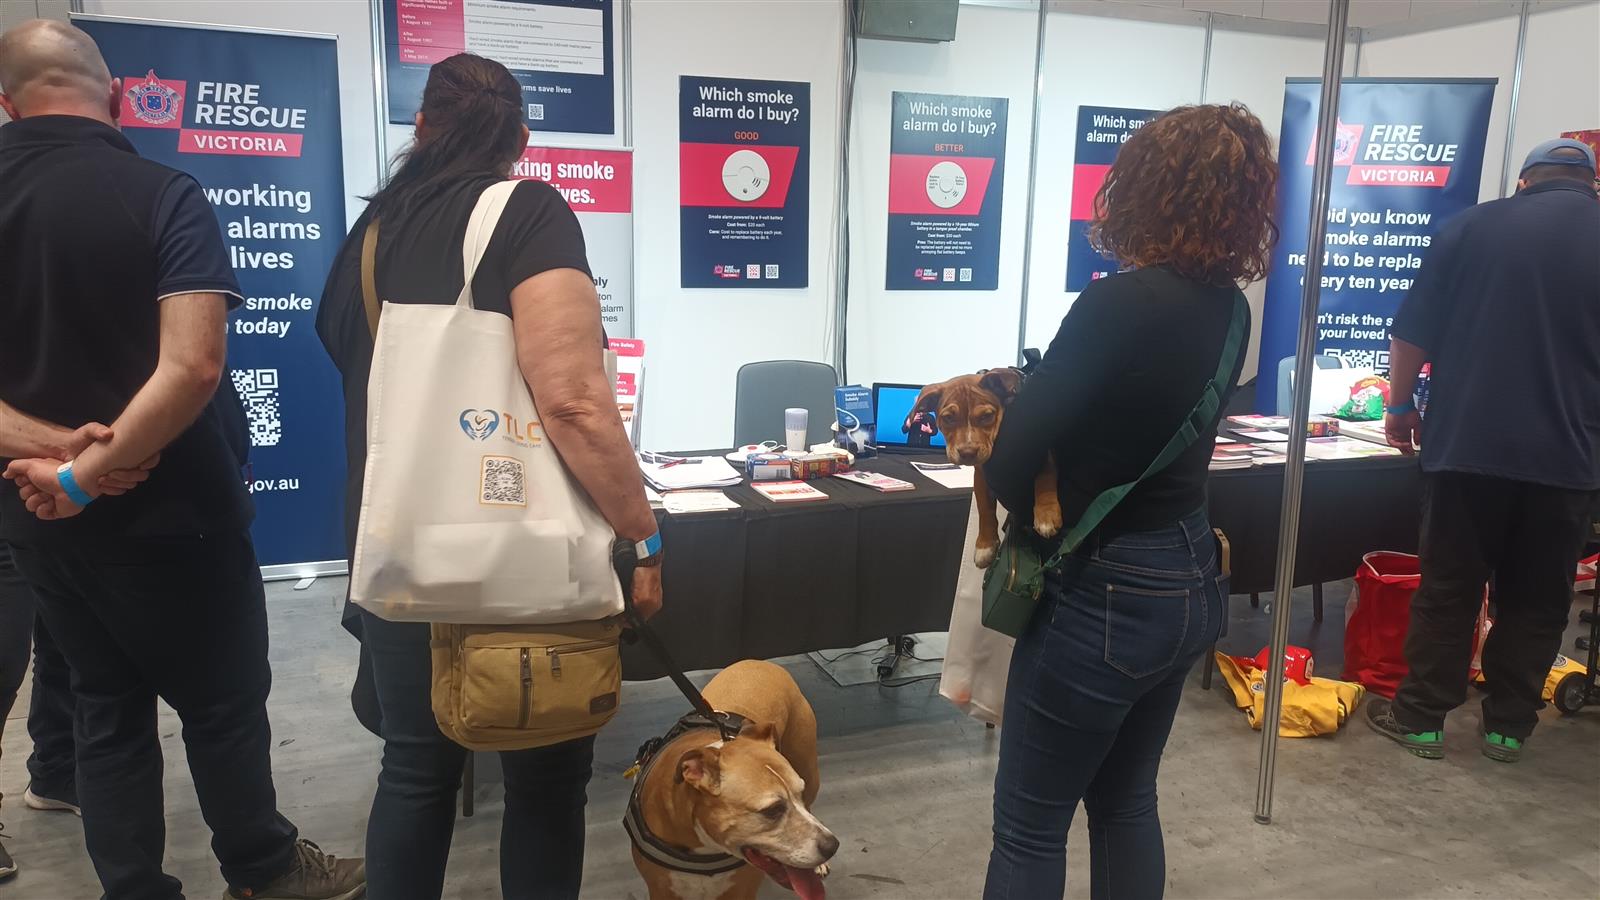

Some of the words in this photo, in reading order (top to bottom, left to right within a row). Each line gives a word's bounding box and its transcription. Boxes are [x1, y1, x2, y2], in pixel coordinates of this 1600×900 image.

[197, 81, 260, 105] FIRE
[556, 85, 572, 94] lives
[699, 85, 743, 102] Which
[747, 89, 794, 104] smoke
[194, 103, 307, 129] RESCUE
[692, 103, 734, 119] alarm
[737, 105, 755, 119] do
[759, 107, 763, 119] I
[767, 108, 800, 124] buy?
[909, 101, 948, 117] Which
[951, 104, 992, 118] smoke
[903, 117, 938, 132] alarm
[942, 119, 958, 133] do
[961, 120, 965, 133] I
[968, 121, 997, 137] buy?
[1093, 114, 1126, 129] Which
[193, 134, 287, 152] VICTORIA
[734, 131, 759, 140] GOOD
[1086, 129, 1118, 143] alarm
[1369, 124, 1423, 143] FIRE
[934, 143, 964, 152] BETTER
[1363, 143, 1458, 162] RESCUE
[512, 157, 552, 182] king
[557, 160, 614, 180] smoke
[1360, 169, 1436, 183] VICTORIA
[202, 183, 312, 214] working
[552, 183, 596, 204] ves.
[1328, 207, 1347, 223] id
[1349, 210, 1381, 227] you
[1385, 208, 1431, 225] know
[227, 215, 321, 240] alarms
[1325, 230, 1369, 246] moke
[1372, 231, 1432, 248] alarms
[230, 245, 294, 269] lives
[1288, 250, 1329, 266] ned
[1333, 252, 1349, 267] to
[1353, 252, 1374, 268] be
[1378, 253, 1422, 272] repla
[1300, 275, 1345, 291] ery
[1348, 274, 1375, 289] ten
[1379, 278, 1414, 293] yea
[245, 293, 313, 311] smoke
[598, 293, 612, 301] ton
[601, 313, 618, 323] mes
[1317, 312, 1333, 325] n't
[1335, 312, 1359, 326] risk
[1361, 313, 1383, 326] the
[234, 317, 291, 339] today
[1319, 328, 1348, 340] your
[1350, 327, 1385, 340] loved
[503, 412, 542, 442] TLC
[244, 477, 300, 494] ov.au
